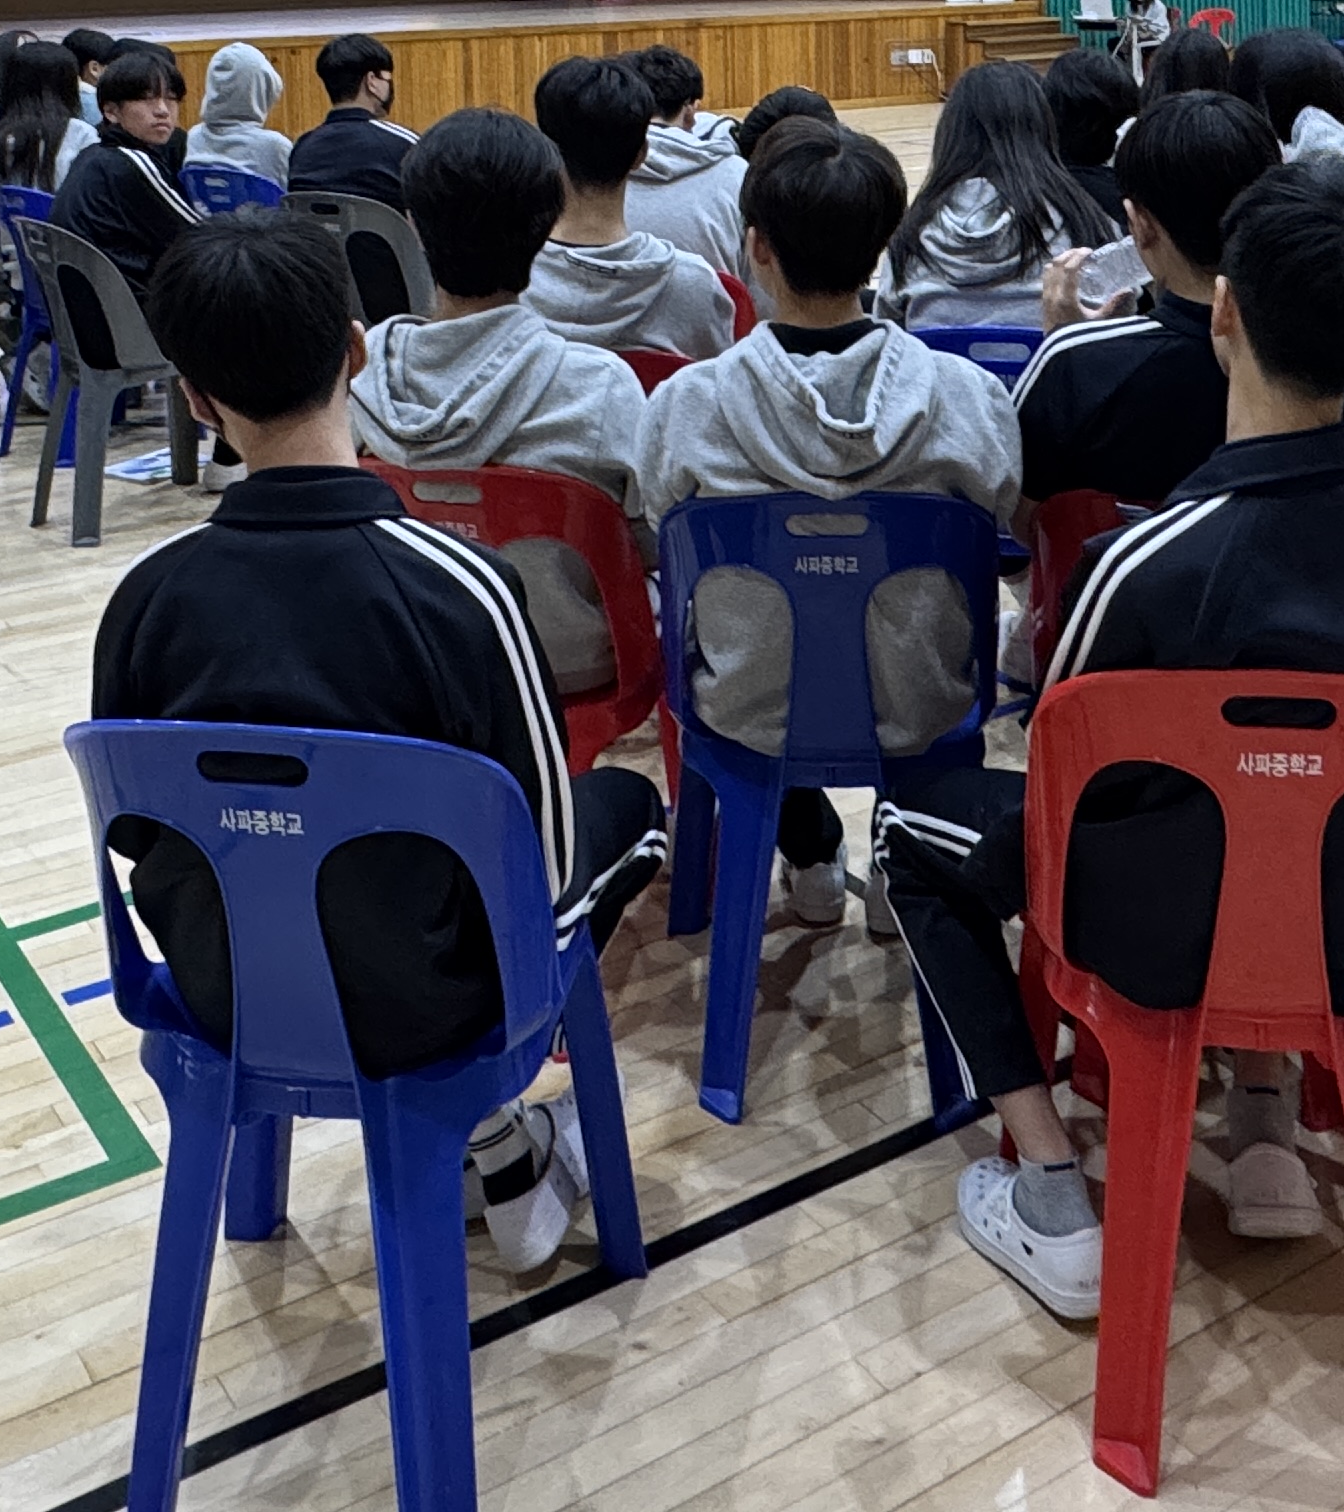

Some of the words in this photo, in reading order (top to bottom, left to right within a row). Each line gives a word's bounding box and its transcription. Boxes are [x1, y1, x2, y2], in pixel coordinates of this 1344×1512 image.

[794, 555, 860, 576] 사파중학교
[1236, 752, 1324, 778] 사파중학교
[219, 807, 305, 837] 사파중학교
